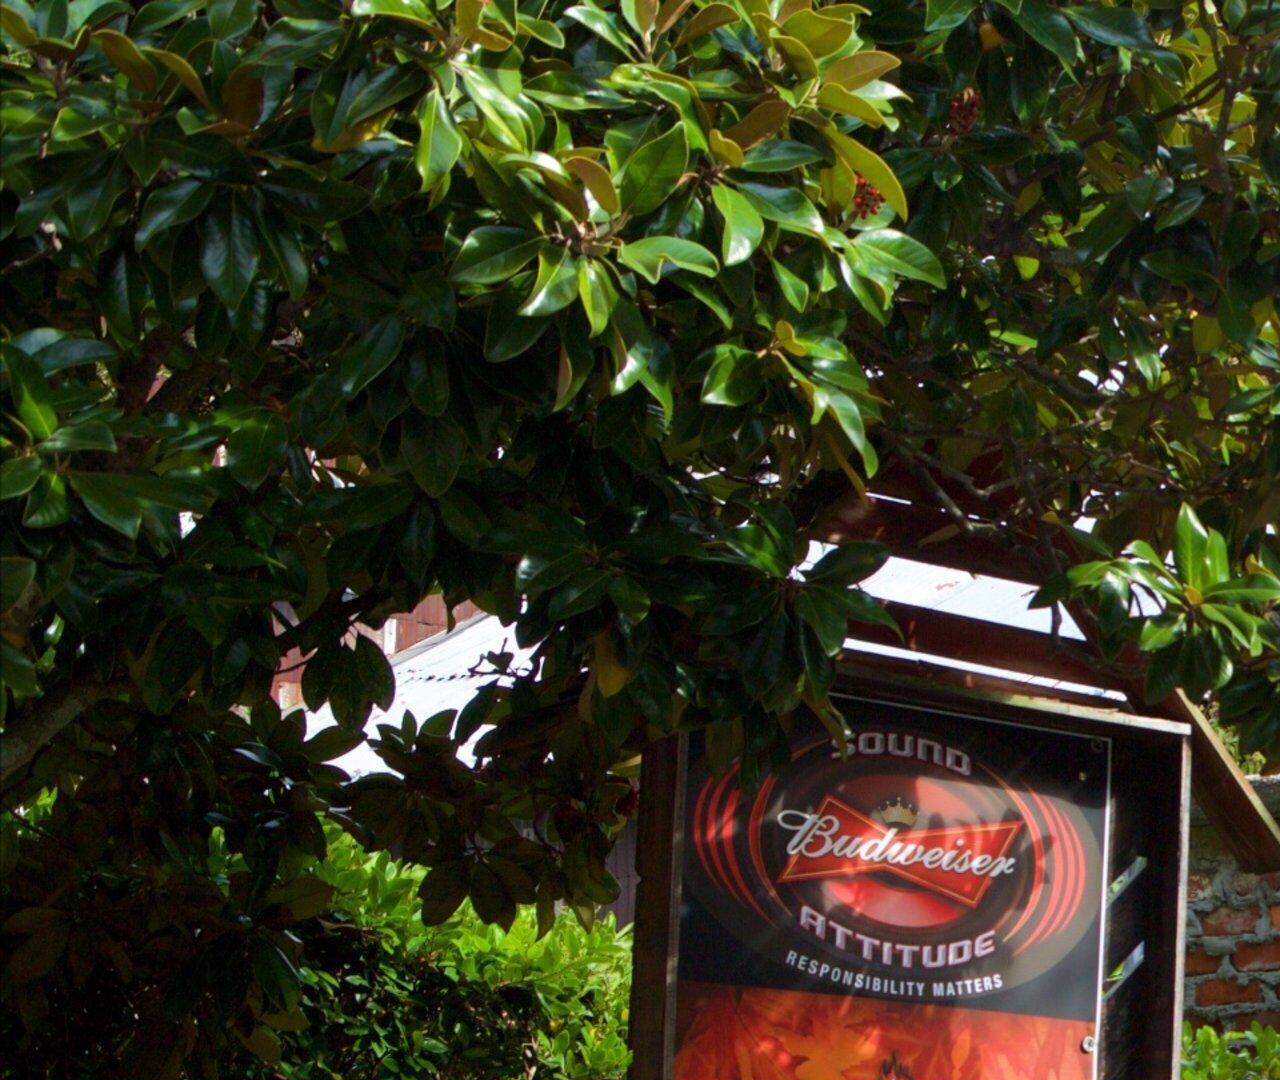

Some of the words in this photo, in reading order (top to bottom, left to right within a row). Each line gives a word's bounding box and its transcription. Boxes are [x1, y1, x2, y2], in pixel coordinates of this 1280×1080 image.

[832, 731, 972, 776] SOUND
[777, 809, 1017, 878] Budweiser
[800, 906, 995, 969] ATTITUDE
[786, 950, 924, 996] RESPONSIBILITY
[933, 974, 1004, 996] MATTERS
